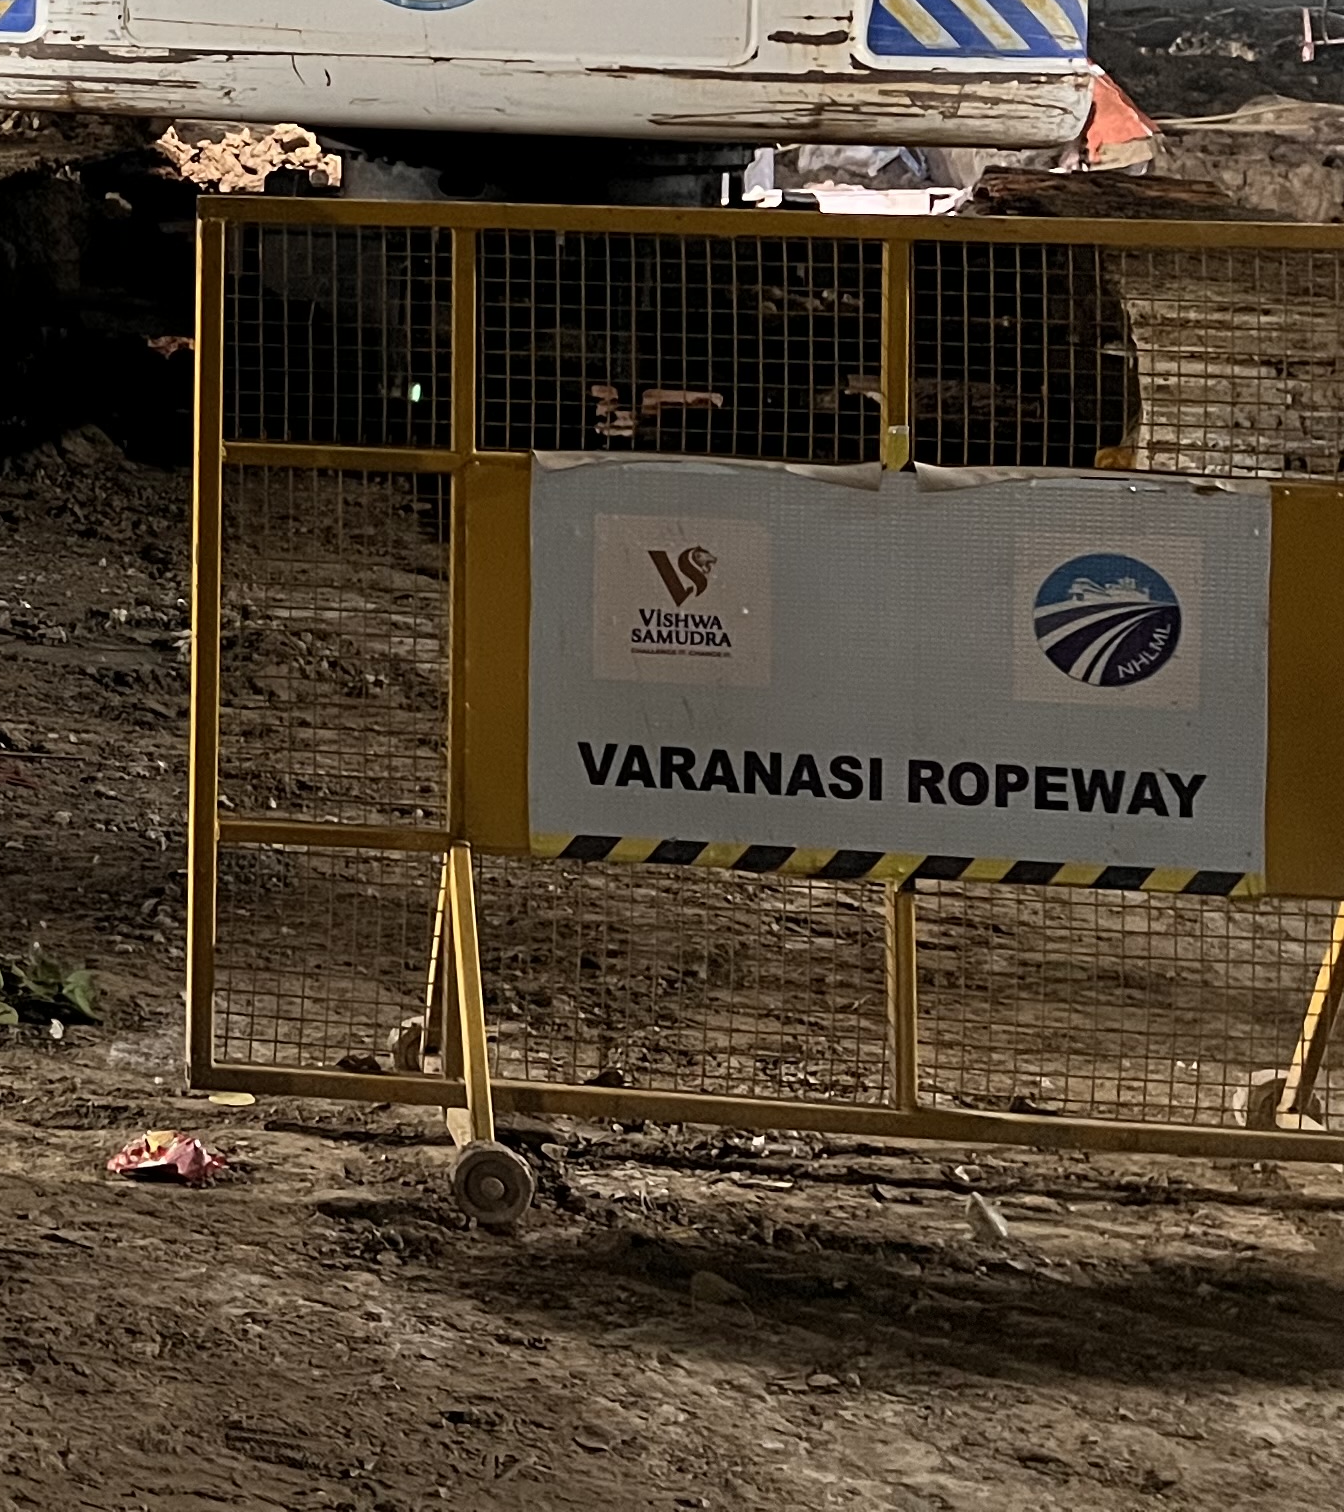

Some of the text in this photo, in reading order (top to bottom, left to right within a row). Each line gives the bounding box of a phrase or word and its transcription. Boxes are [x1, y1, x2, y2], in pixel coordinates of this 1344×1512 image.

[631, 628, 732, 648] SAMUDRA
[638, 608, 723, 630] VISHWA
[1117, 623, 1172, 679] NHLML
[578, 740, 1207, 819] VARANASI ROPEWAY
